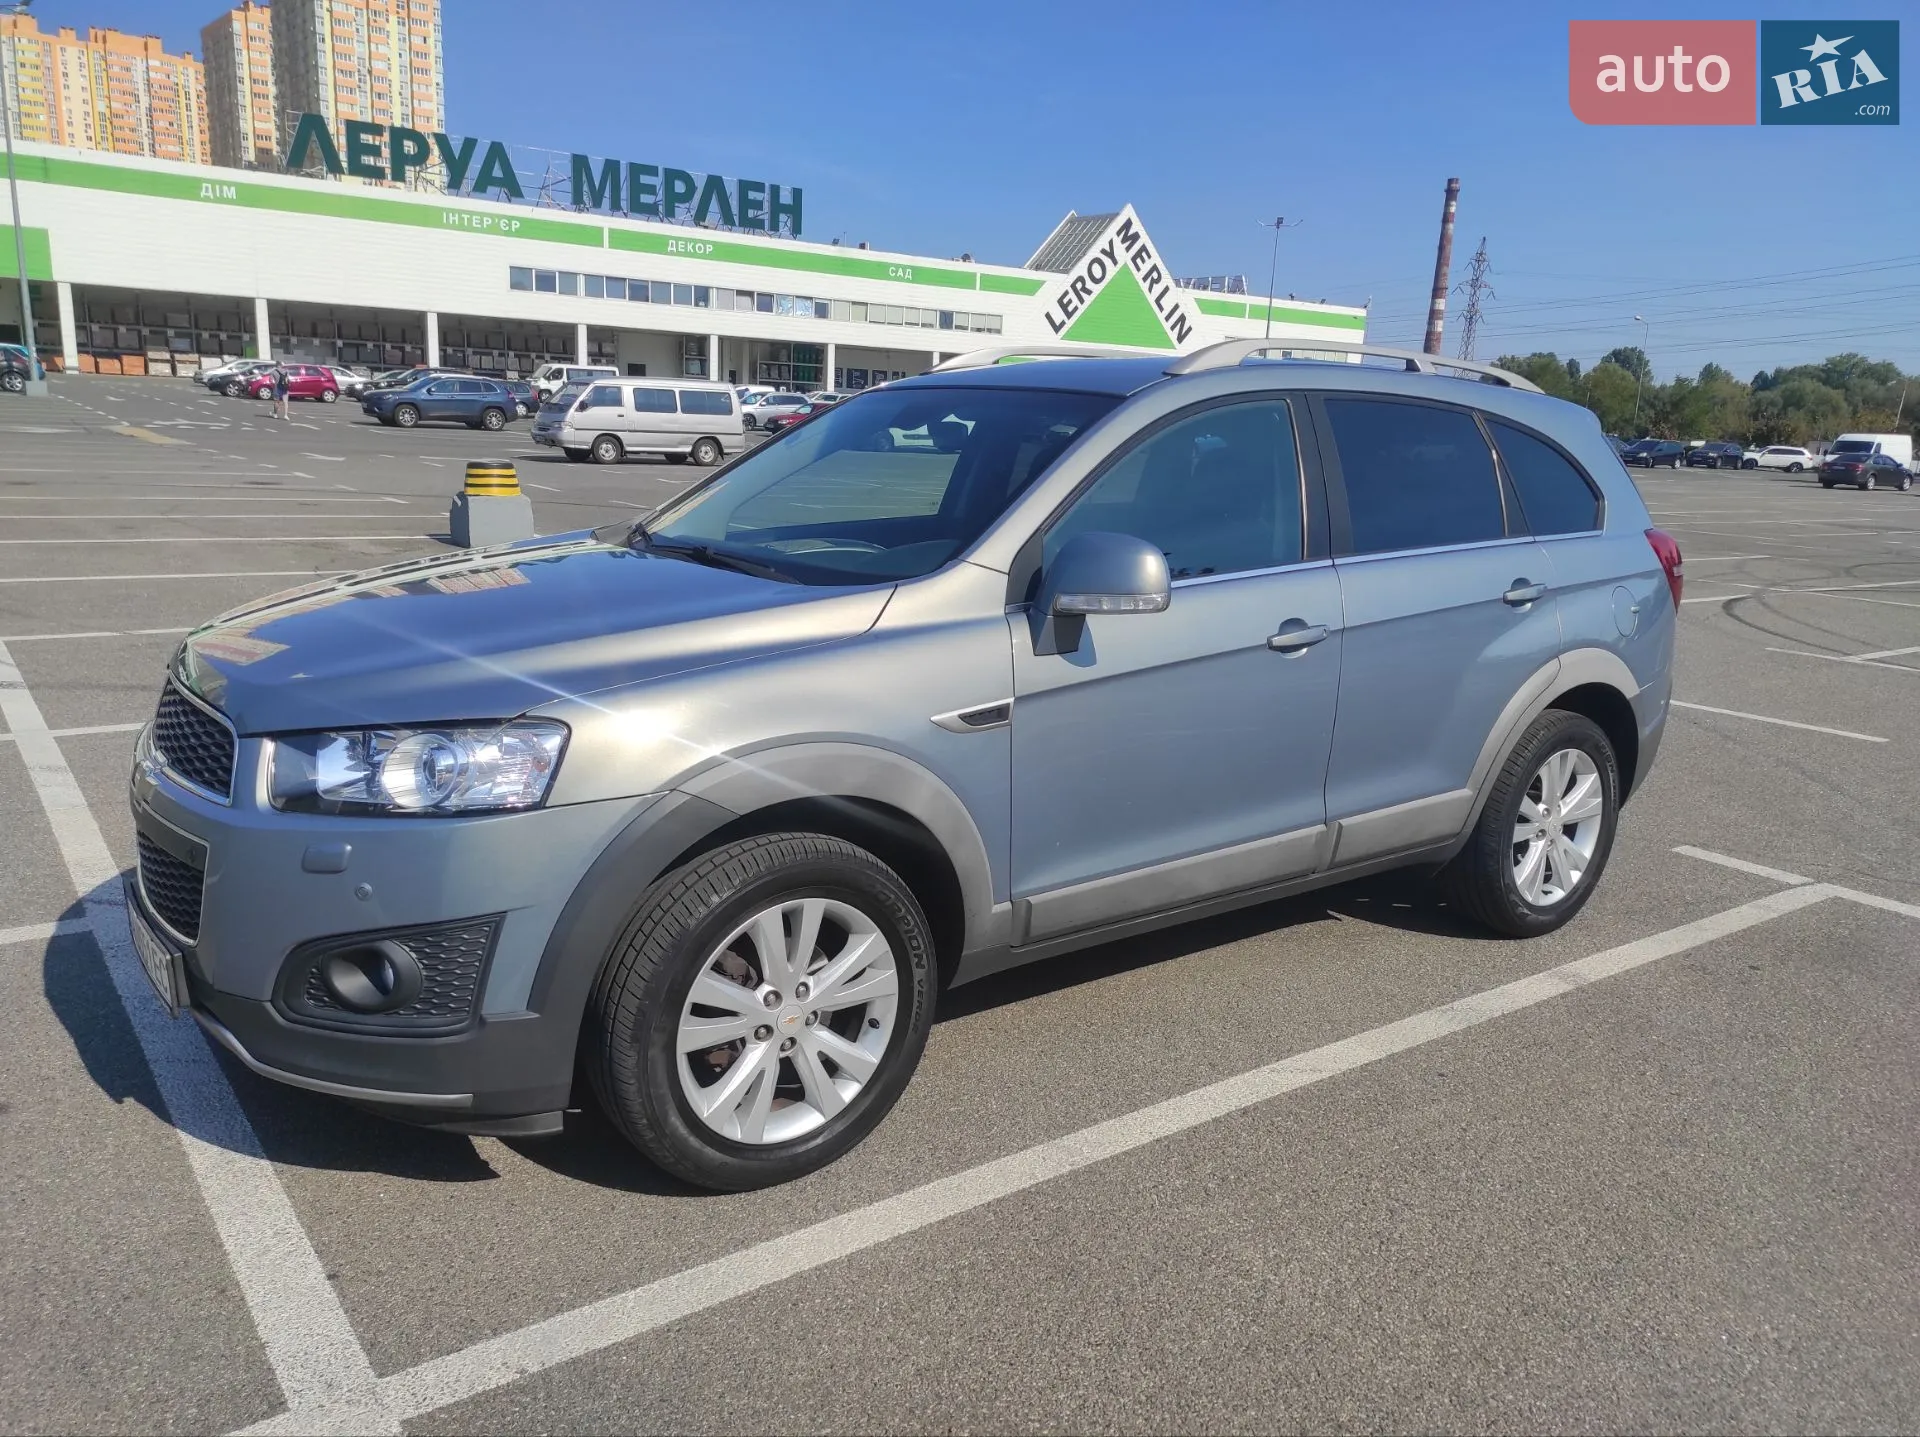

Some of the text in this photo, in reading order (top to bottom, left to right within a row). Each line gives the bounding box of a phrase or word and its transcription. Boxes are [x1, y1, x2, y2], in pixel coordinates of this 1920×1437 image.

[286, 113, 803, 236] ЛЕРУА МЕРЛЕН
[200, 183, 237, 200] ДІМ
[667, 239, 713, 255] ДЕКОР
[888, 266, 913, 281] САД
[1044, 217, 1192, 345] LEROY MERLIN
